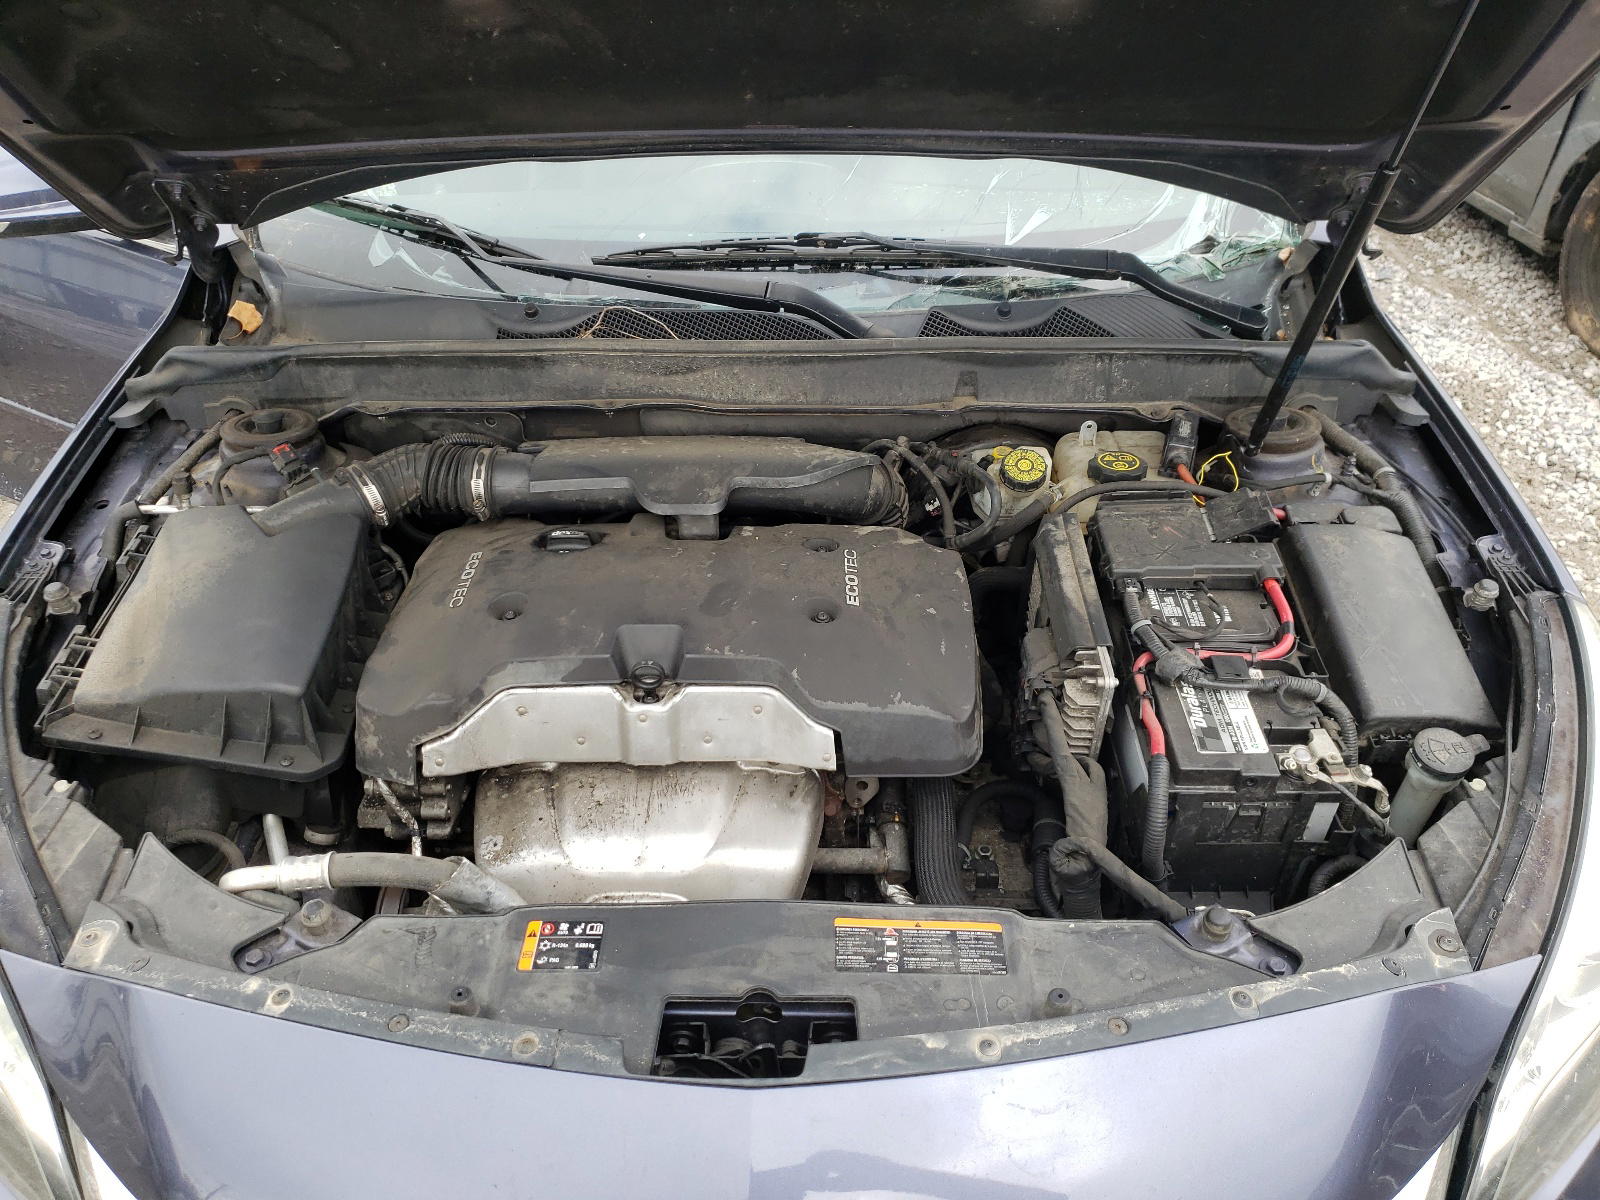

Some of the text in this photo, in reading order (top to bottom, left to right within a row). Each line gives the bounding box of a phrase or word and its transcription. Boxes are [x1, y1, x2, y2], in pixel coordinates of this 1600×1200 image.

[450, 551, 483, 608] ECOTEC
[844, 549, 860, 606] ECOTEC
[1180, 680, 1208, 730] Durala
